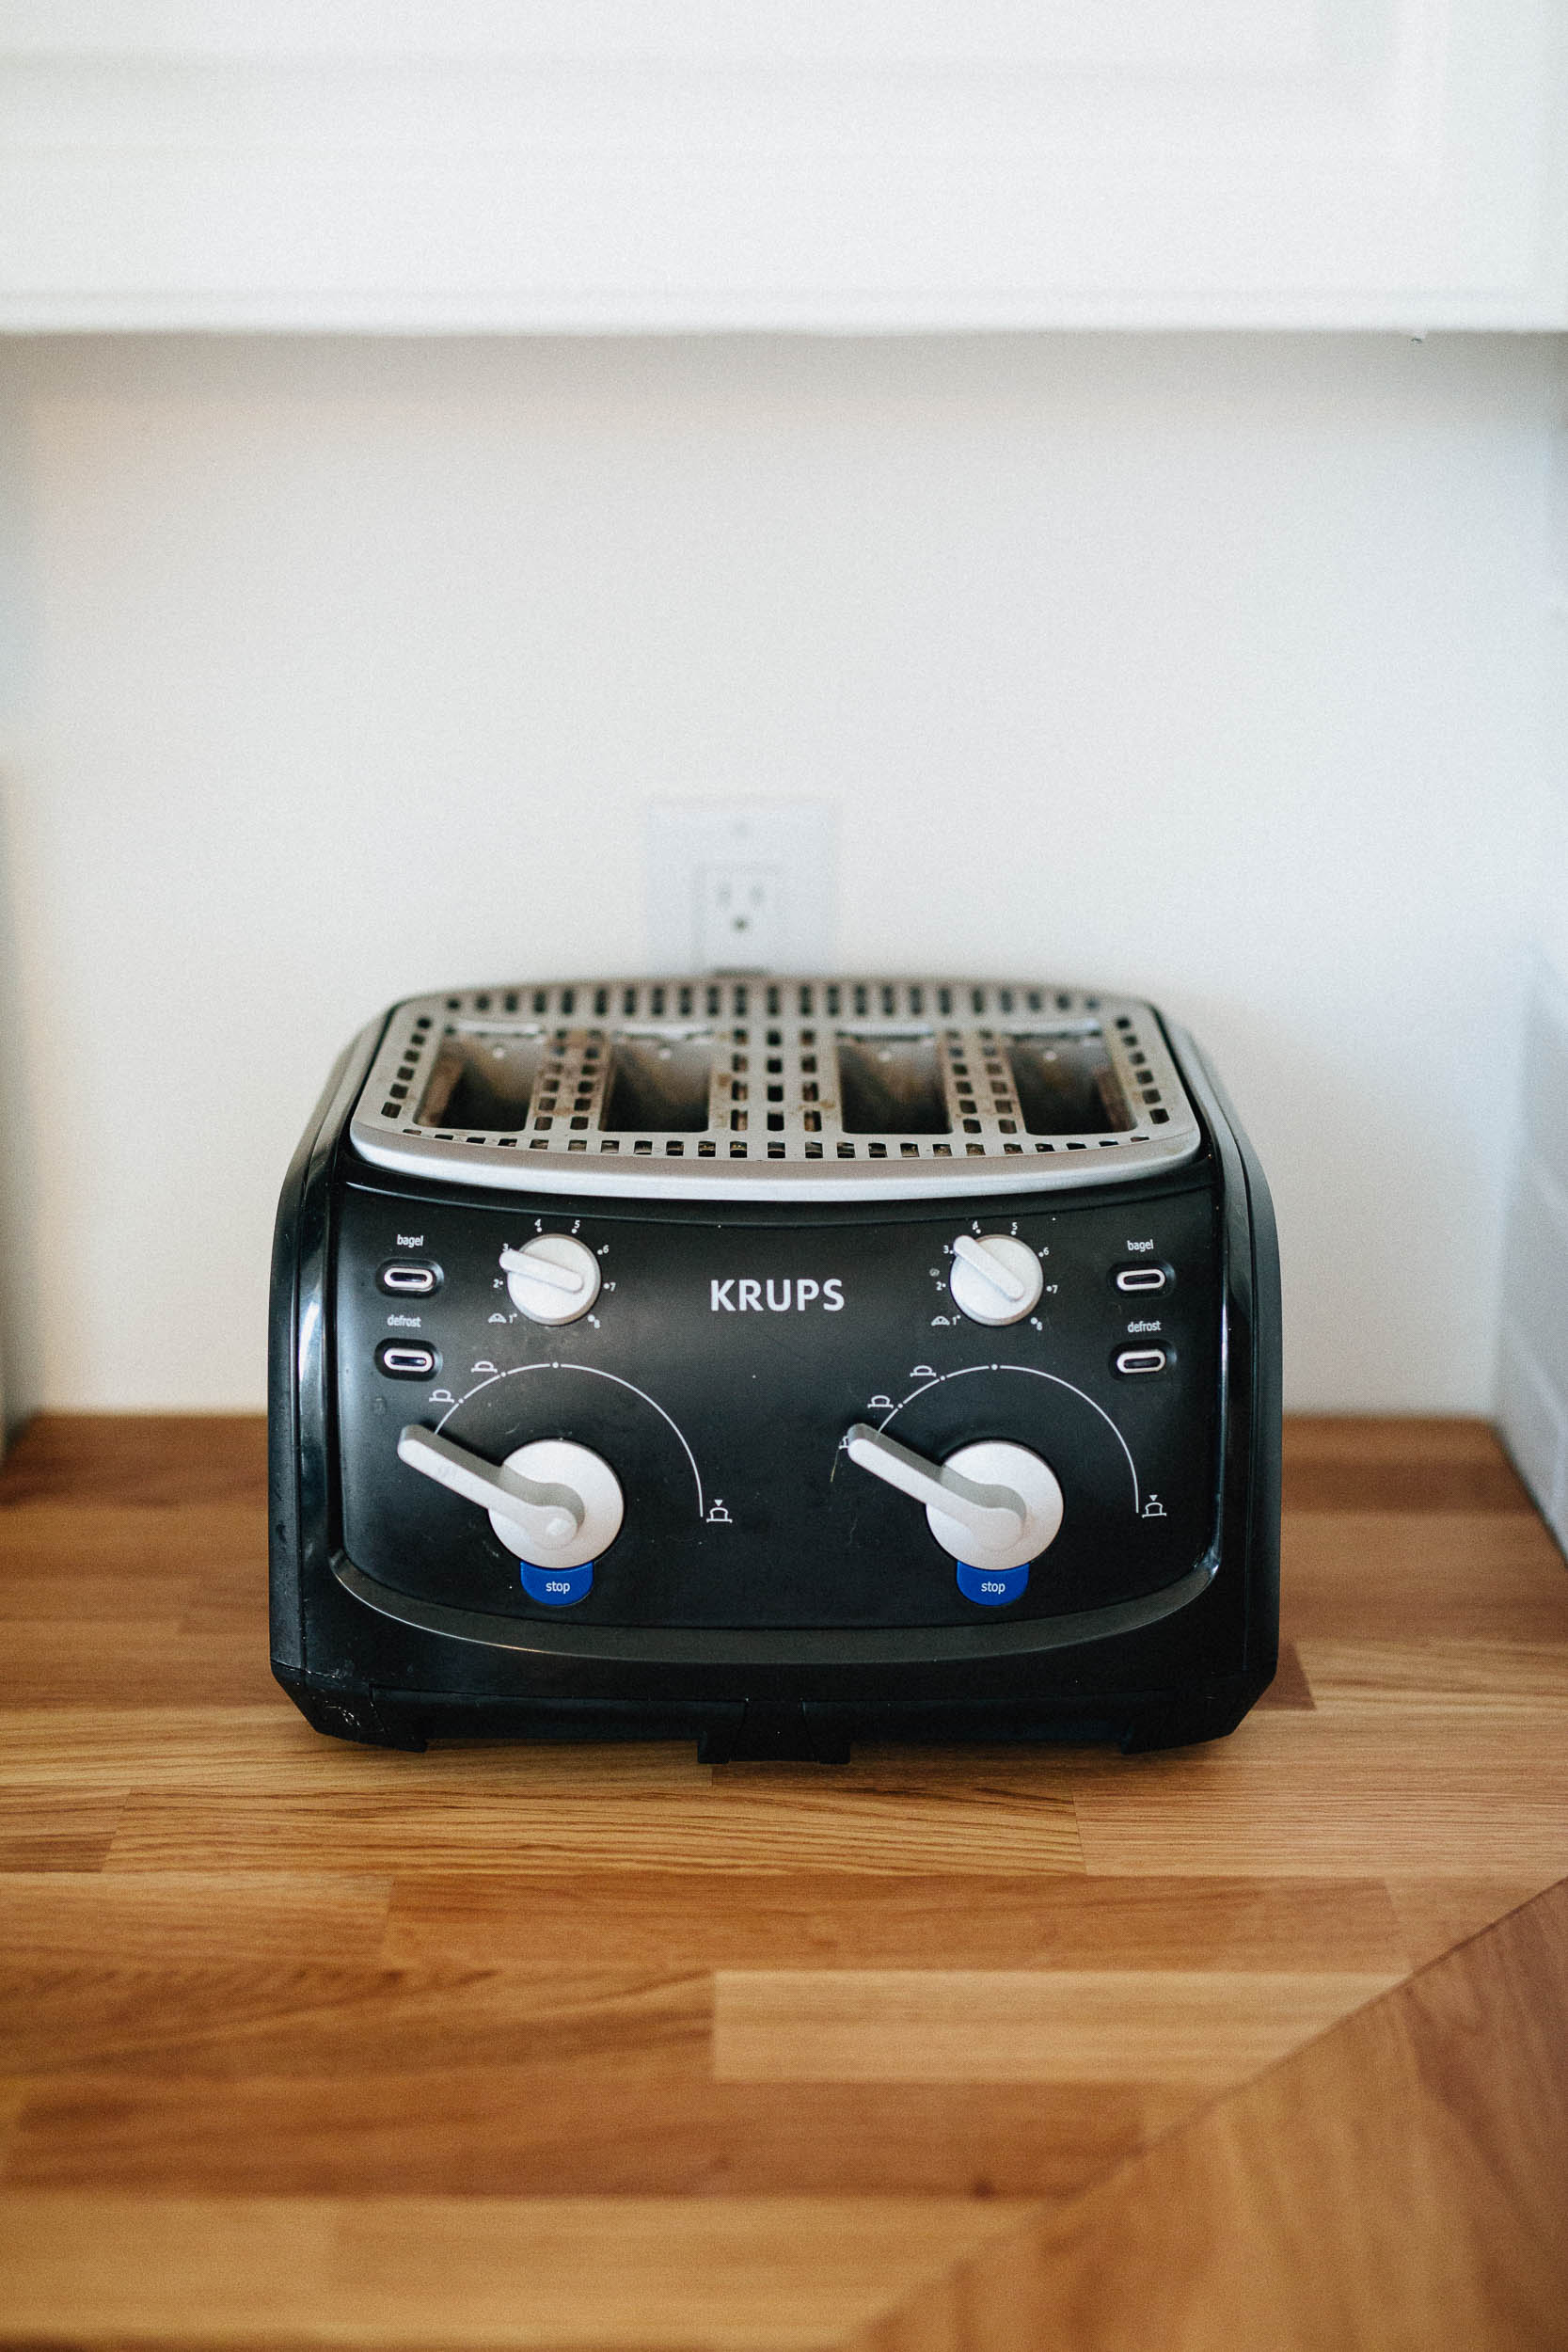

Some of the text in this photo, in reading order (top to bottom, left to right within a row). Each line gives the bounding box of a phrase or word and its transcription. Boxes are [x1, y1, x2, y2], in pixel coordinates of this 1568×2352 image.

[534, 1218, 542, 1227] 4
[574, 1220, 580, 1229] 5
[1012, 1222, 1018, 1231] 5
[396, 1234, 424, 1248] bagel
[1127, 1239, 1154, 1252] bagel
[602, 1245, 610, 1254] 6
[943, 1245, 949, 1254] 3
[1043, 1248, 1050, 1256] 6
[493, 1279, 499, 1289] 2
[610, 1281, 616, 1292] 7
[936, 1281, 942, 1291] 2
[1052, 1284, 1058, 1294] 7
[710, 1279, 845, 1311] KRUPS
[387, 1314, 421, 1327] defrost
[594, 1319, 601, 1328] 8
[953, 1316, 957, 1326] 1
[1127, 1320, 1162, 1333] defrost
[546, 1581, 571, 1595] stop
[981, 1581, 1006, 1595] stop
